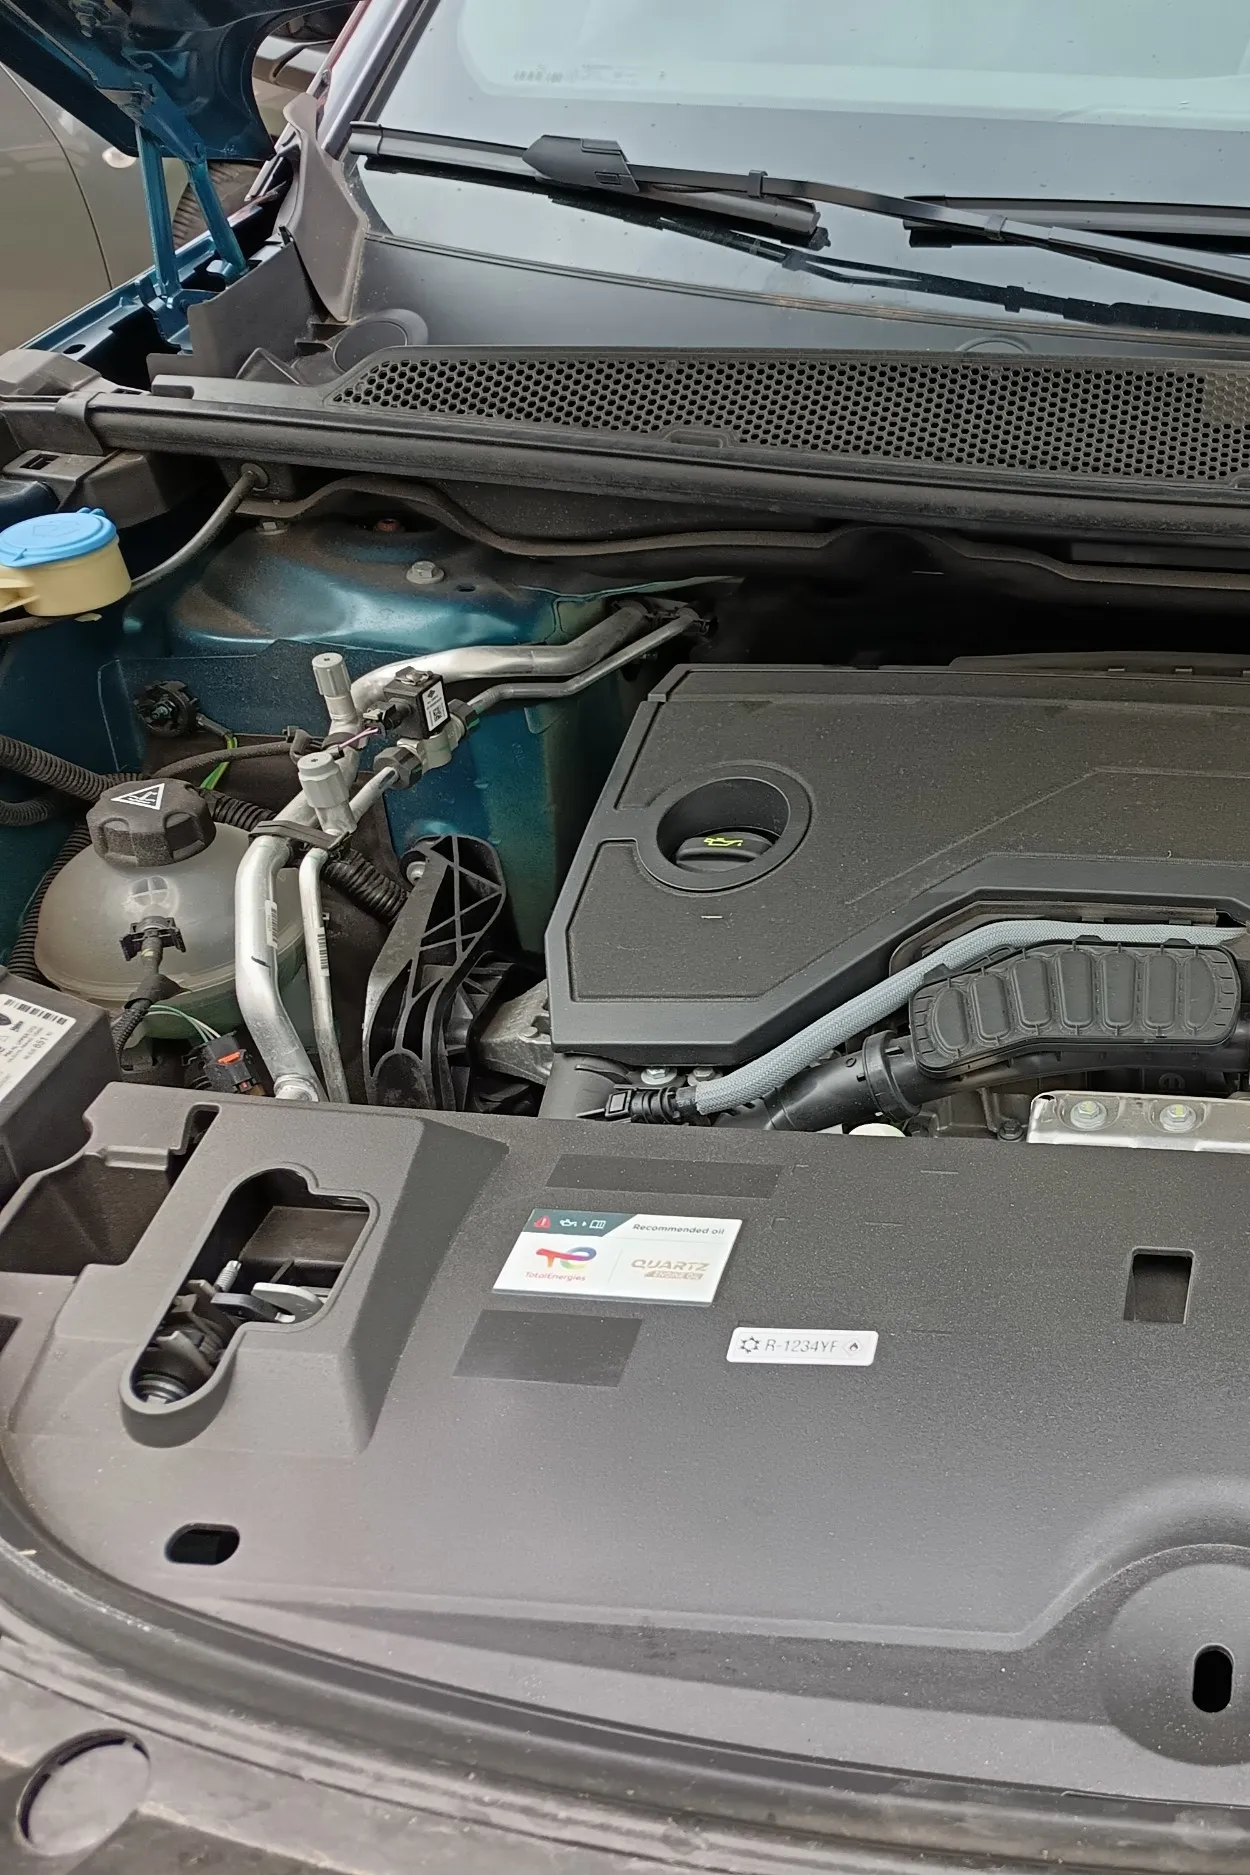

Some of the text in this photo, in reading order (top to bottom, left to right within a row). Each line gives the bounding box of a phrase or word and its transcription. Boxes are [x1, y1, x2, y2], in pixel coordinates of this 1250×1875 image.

[633, 1223, 725, 1236] Recommended oil
[631, 1259, 710, 1272] QUARTZ
[525, 1271, 586, 1282] TotalEnergies
[765, 1338, 838, 1353] R-1234YF
